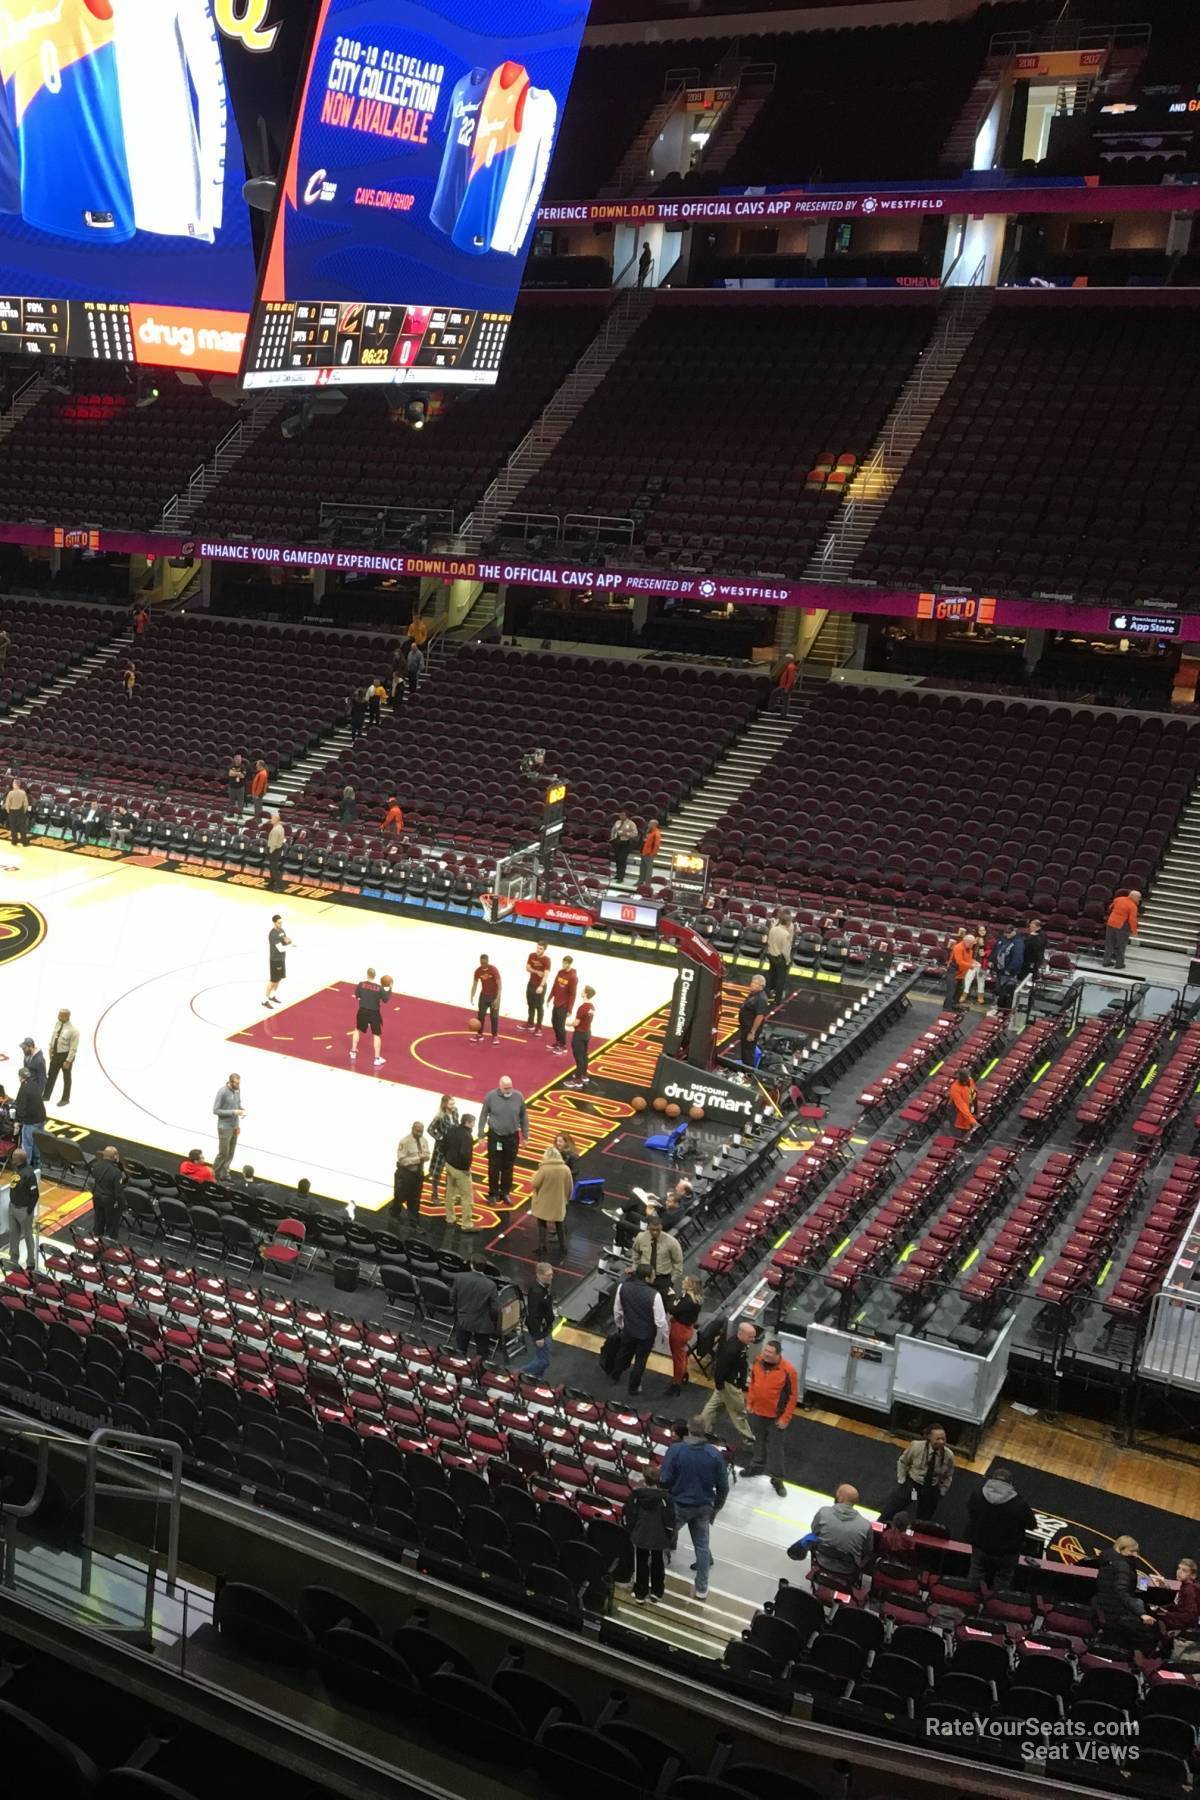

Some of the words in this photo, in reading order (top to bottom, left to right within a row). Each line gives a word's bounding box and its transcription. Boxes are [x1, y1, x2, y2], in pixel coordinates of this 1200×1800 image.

[334, 36, 378, 66] 2018-19
[381, 50, 444, 83] CLEVELAND
[328, 58, 361, 96] CITY
[359, 65, 440, 113] COLLECTION
[321, 90, 357, 128] NOW
[353, 101, 432, 144] AVAILABLE
[1169, 103, 1186, 112] AND
[457, 116, 475, 147] 22
[354, 187, 415, 211] CAVS.COM/SHOP
[537, 206, 588, 220] PERIENCE
[590, 204, 655, 218] DOWNLOAD
[657, 204, 678, 217] THE
[682, 202, 732, 216] OFFICIAL
[735, 202, 764, 215] CAVS
[767, 201, 791, 214] APP
[795, 201, 843, 213] PRESENTED
[845, 200, 857, 211] BY
[881, 199, 943, 210] WESTFIELD
[138, 317, 195, 356] drug
[341, 339, 354, 365] 0
[361, 348, 389, 365] 86:23
[399, 339, 412, 364] 0
[201, 544, 248, 558] ENHANCE
[251, 548, 280, 561] YOUR
[283, 550, 334, 566] GAMEDAY
[337, 554, 403, 571] EXPERIENCE
[407, 559, 475, 576] DOWNLOAD
[478, 564, 500, 578] THE
[504, 566, 558, 584] OFFICIAL
[561, 571, 593, 586] CAVS
[597, 573, 622, 588] APP
[626, 577, 678, 591] PRESENTED
[681, 581, 694, 593] BY
[720, 586, 788, 599] WESTFIELD
[1130, 622, 1149, 632] App
[1150, 624, 1174, 633] Store
[556, 910, 589, 922] StateFarm
[677, 981, 690, 1016] Cleveland
[675, 1016, 686, 1037] Clinic
[664, 1082, 706, 1108] drug
[708, 1093, 753, 1117] mart
[691, 1083, 729, 1098] DISCOUNT
